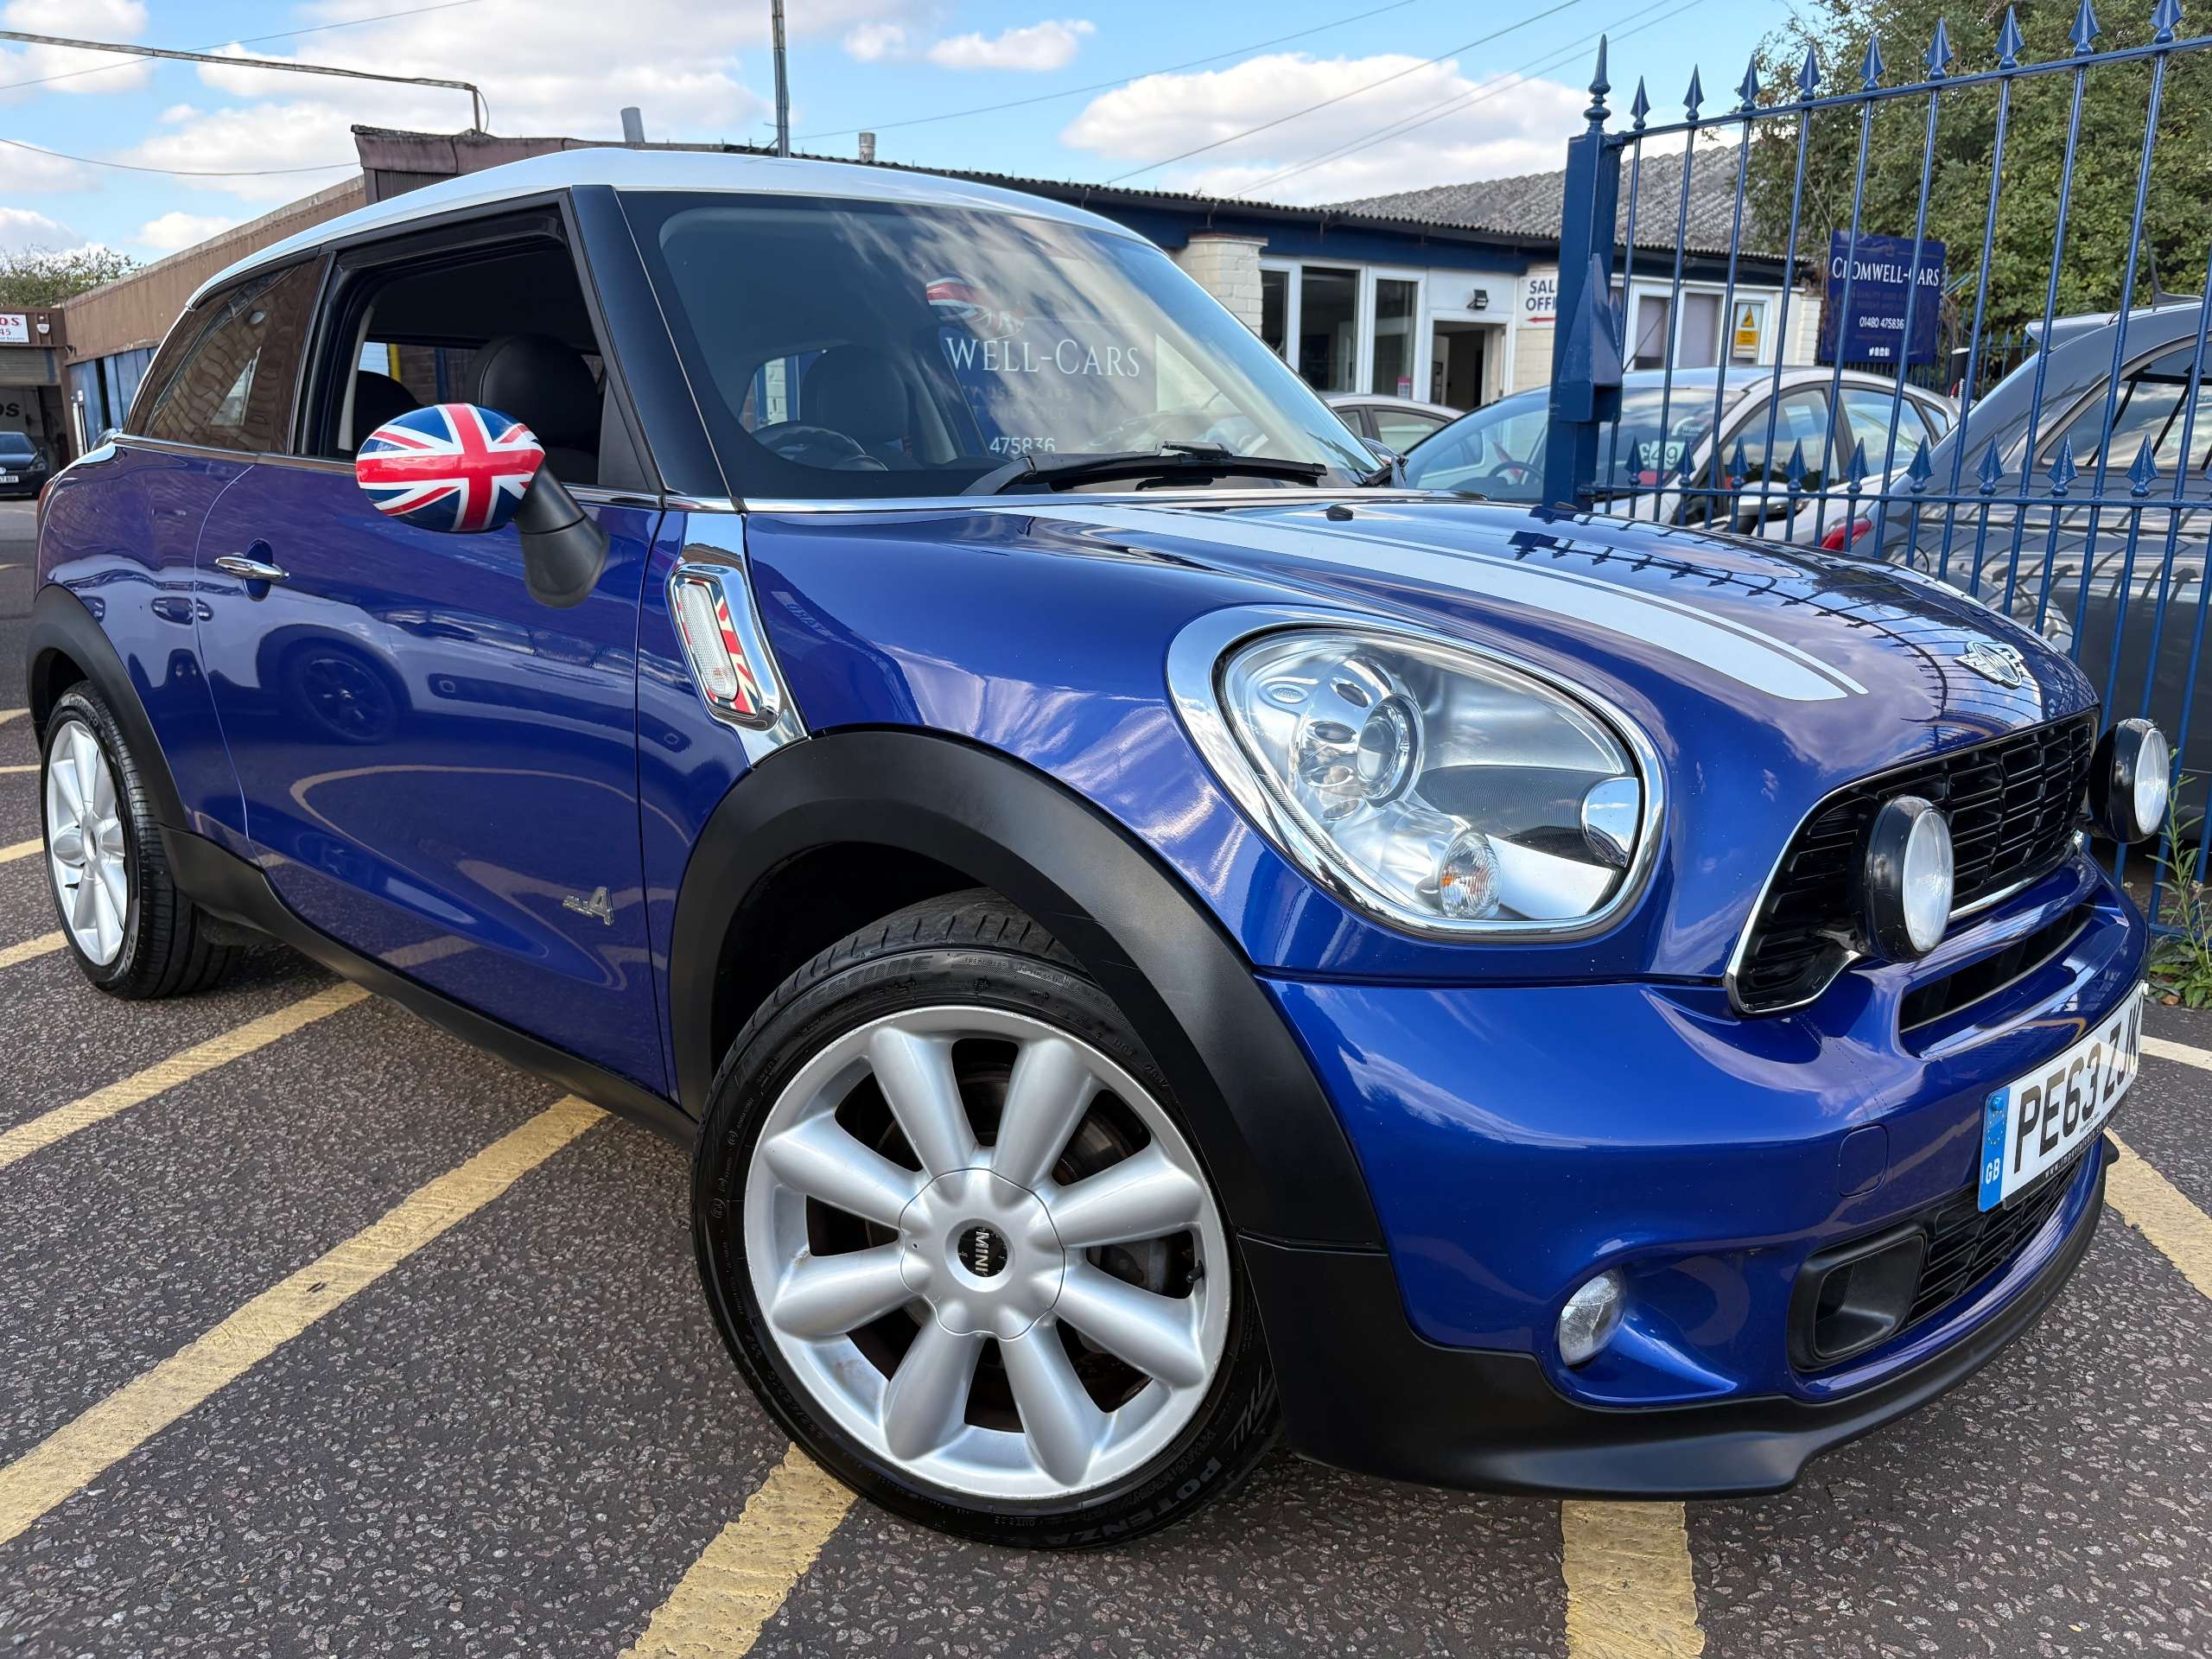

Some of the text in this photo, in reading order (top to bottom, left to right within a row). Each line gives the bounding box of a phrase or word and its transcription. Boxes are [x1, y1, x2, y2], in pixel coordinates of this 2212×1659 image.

[1529, 280, 1555, 295] SAL
[1832, 256, 1940, 287] COMWELL-ARS
[1859, 316, 1879, 328] 01480
[945, 338, 1140, 378] WELL-CARS
[2014, 1042, 2101, 1175] PE63
[2103, 995, 2141, 1103] ZJK
[1986, 1158, 2000, 1185] GB
[976, 1230, 989, 1272] MINI
[1044, 1457, 1222, 1545] POTENZA
